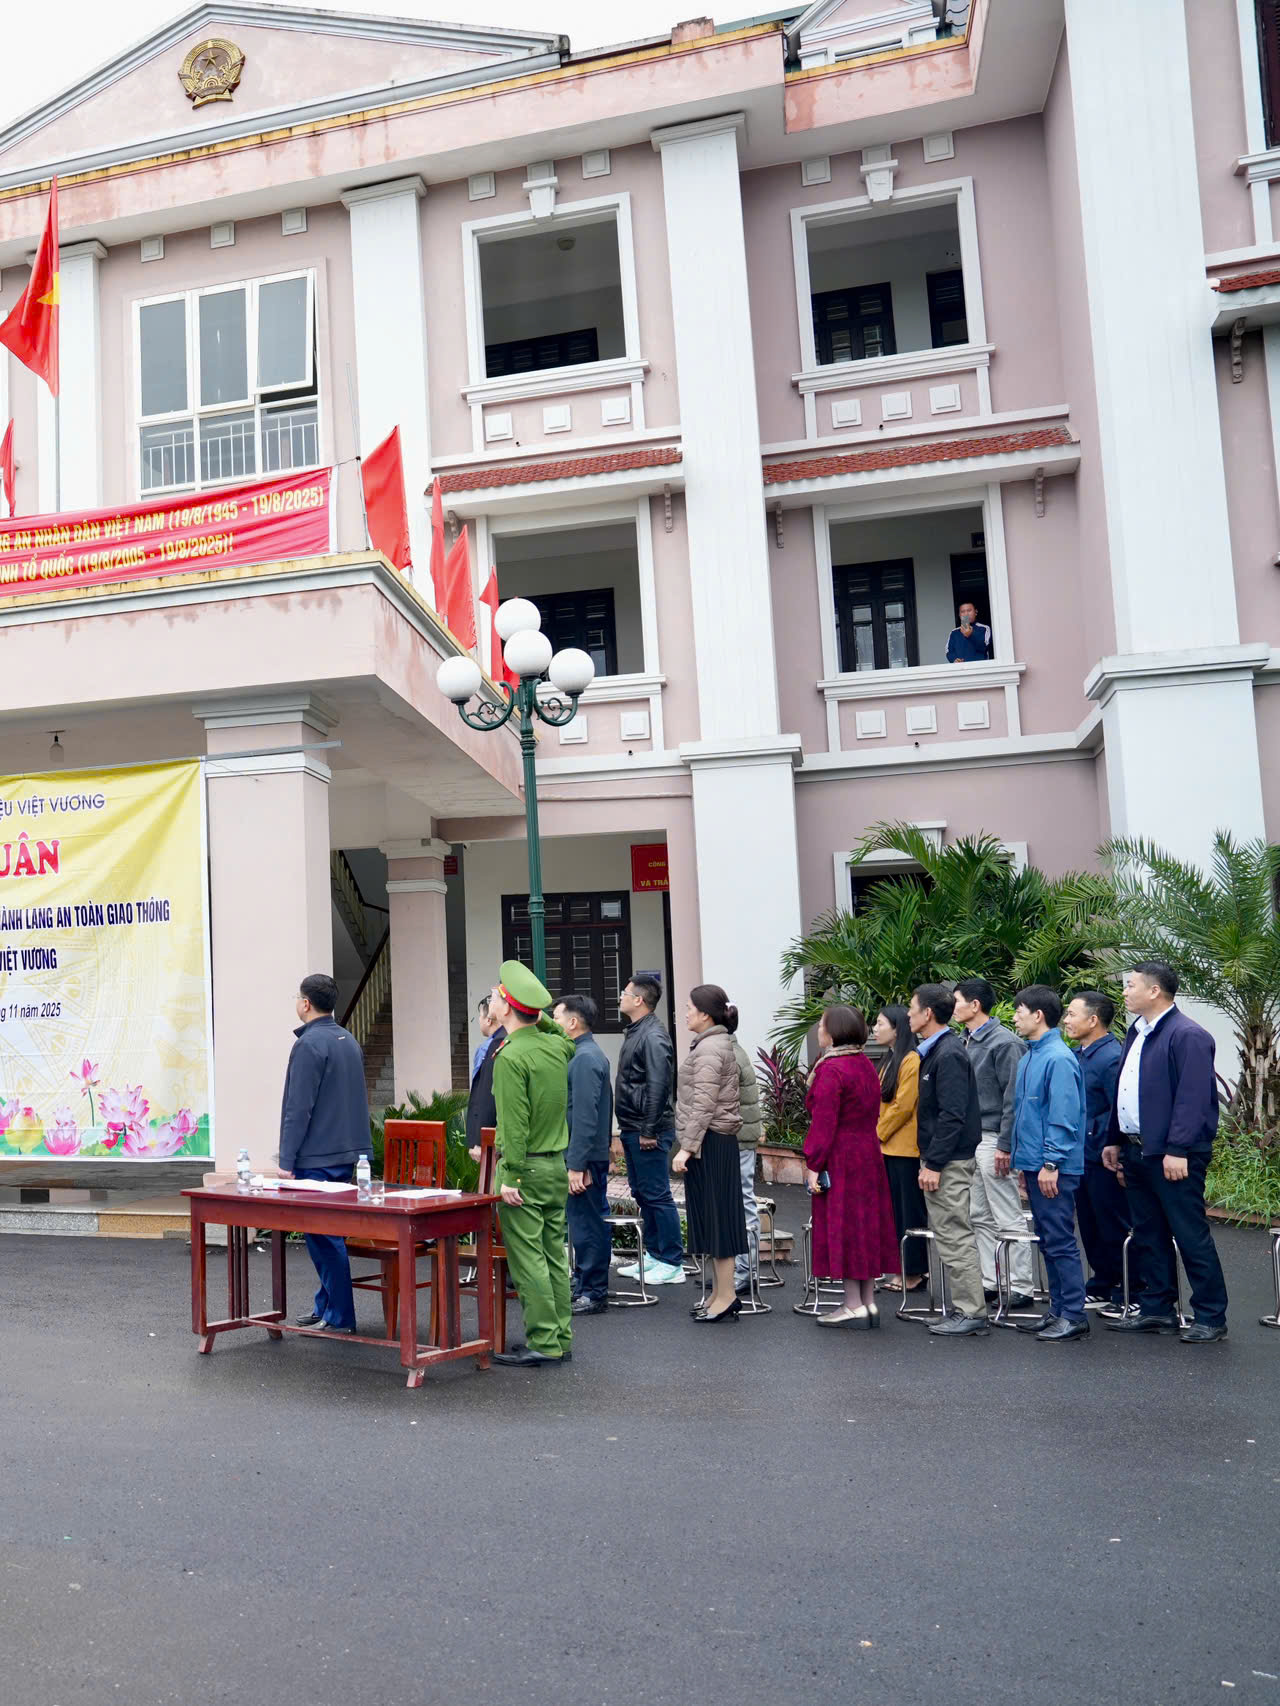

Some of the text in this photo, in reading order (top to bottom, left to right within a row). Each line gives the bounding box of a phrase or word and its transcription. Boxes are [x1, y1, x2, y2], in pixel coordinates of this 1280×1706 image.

[14, 531, 32, 551] AN
[34, 523, 70, 548] NHÂN
[73, 519, 100, 543] DÂN
[103, 514, 131, 540] VIỆT
[134, 512, 165, 533] NAM
[168, 500, 238, 531] (19/8/1945
[251, 485, 324, 517] 19/8/2025)
[22, 552, 38, 581] TỔ
[40, 550, 74, 580] QUỐC
[78, 546, 146, 576] (19/8/2005
[159, 532, 233, 562] 19/8/2025)!
[17, 795, 45, 817] VIỆT
[49, 794, 105, 812] VƯƠNG
[26, 907, 53, 929] LANG
[57, 906, 71, 928] AN
[74, 900, 103, 927] TOÀN
[107, 903, 133, 925] GIAO
[136, 897, 170, 923] THÔNG
[21, 947, 57, 970] VƯƠNG
[9, 1004, 18, 1018] 11
[20, 1005, 38, 1018] năm
[41, 1002, 61, 1017] 2025
